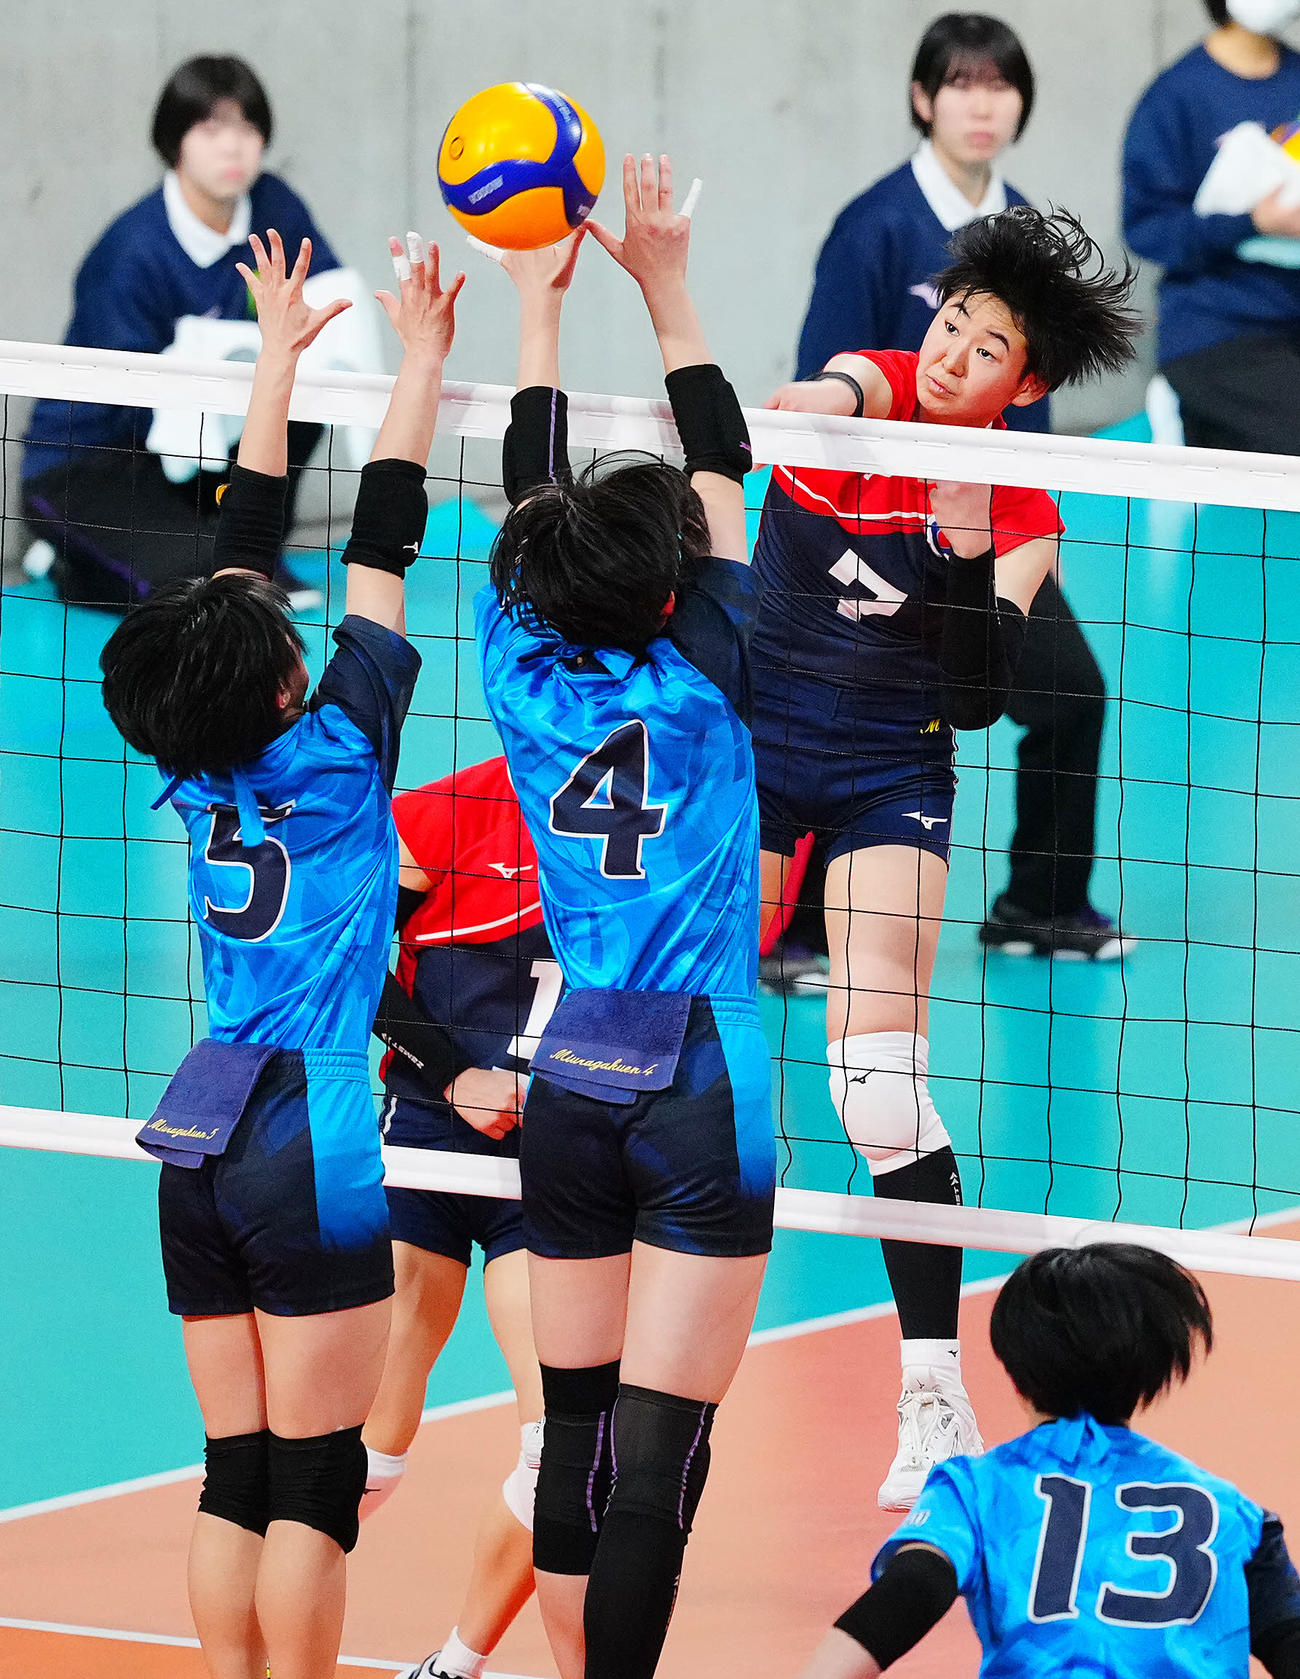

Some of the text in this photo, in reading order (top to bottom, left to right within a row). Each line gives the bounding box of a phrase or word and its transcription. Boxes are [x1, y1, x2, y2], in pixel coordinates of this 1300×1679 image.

[548, 719, 669, 880] 4
[203, 799, 296, 943] 5
[506, 958, 564, 1060] 1
[642, 1063, 659, 1077] 4
[205, 1127, 220, 1140] 5
[1027, 1473, 1220, 1629] 13
